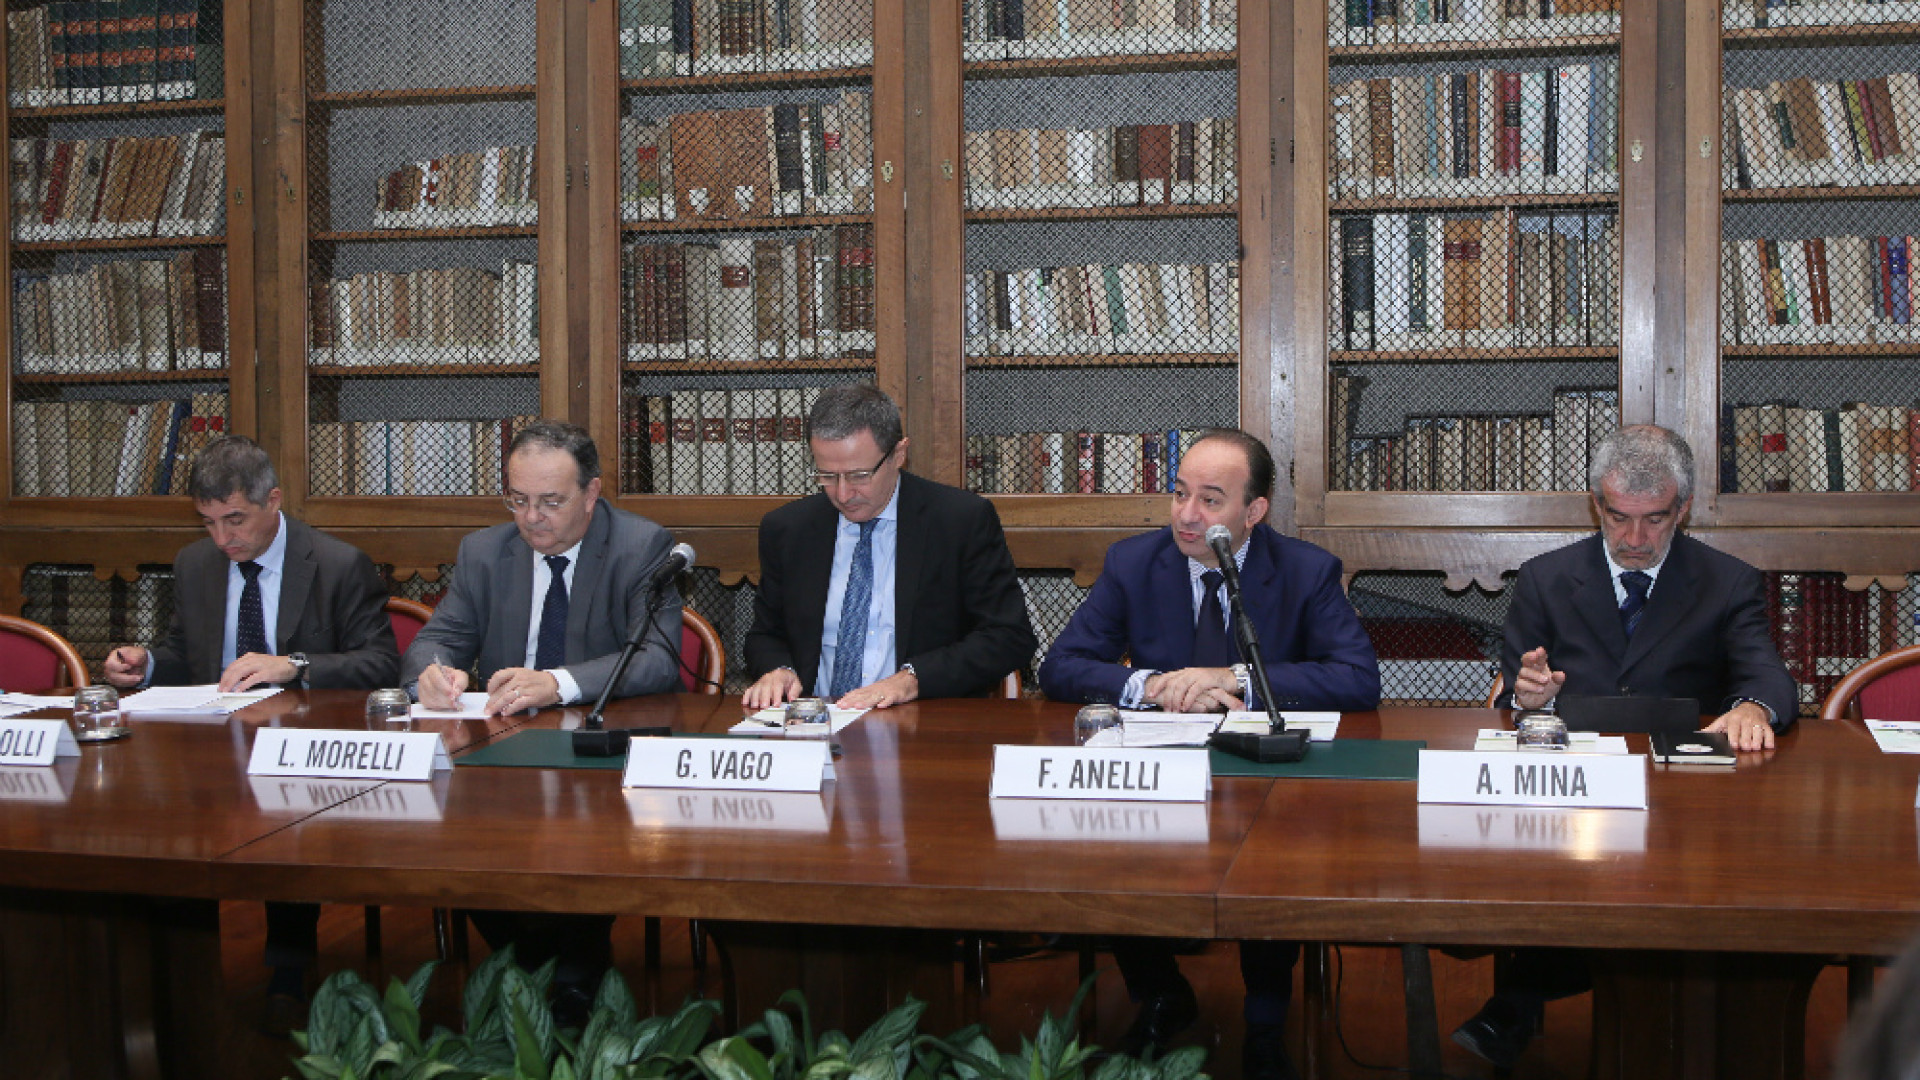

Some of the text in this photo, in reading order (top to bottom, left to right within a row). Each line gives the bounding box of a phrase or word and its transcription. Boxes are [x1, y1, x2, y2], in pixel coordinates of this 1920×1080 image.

[277, 739, 406, 772] L. MORELLI
[676, 749, 773, 781] G. VAGO
[1038, 758, 1161, 791] F. ANELLI
[1476, 763, 1588, 797] A. MINA
